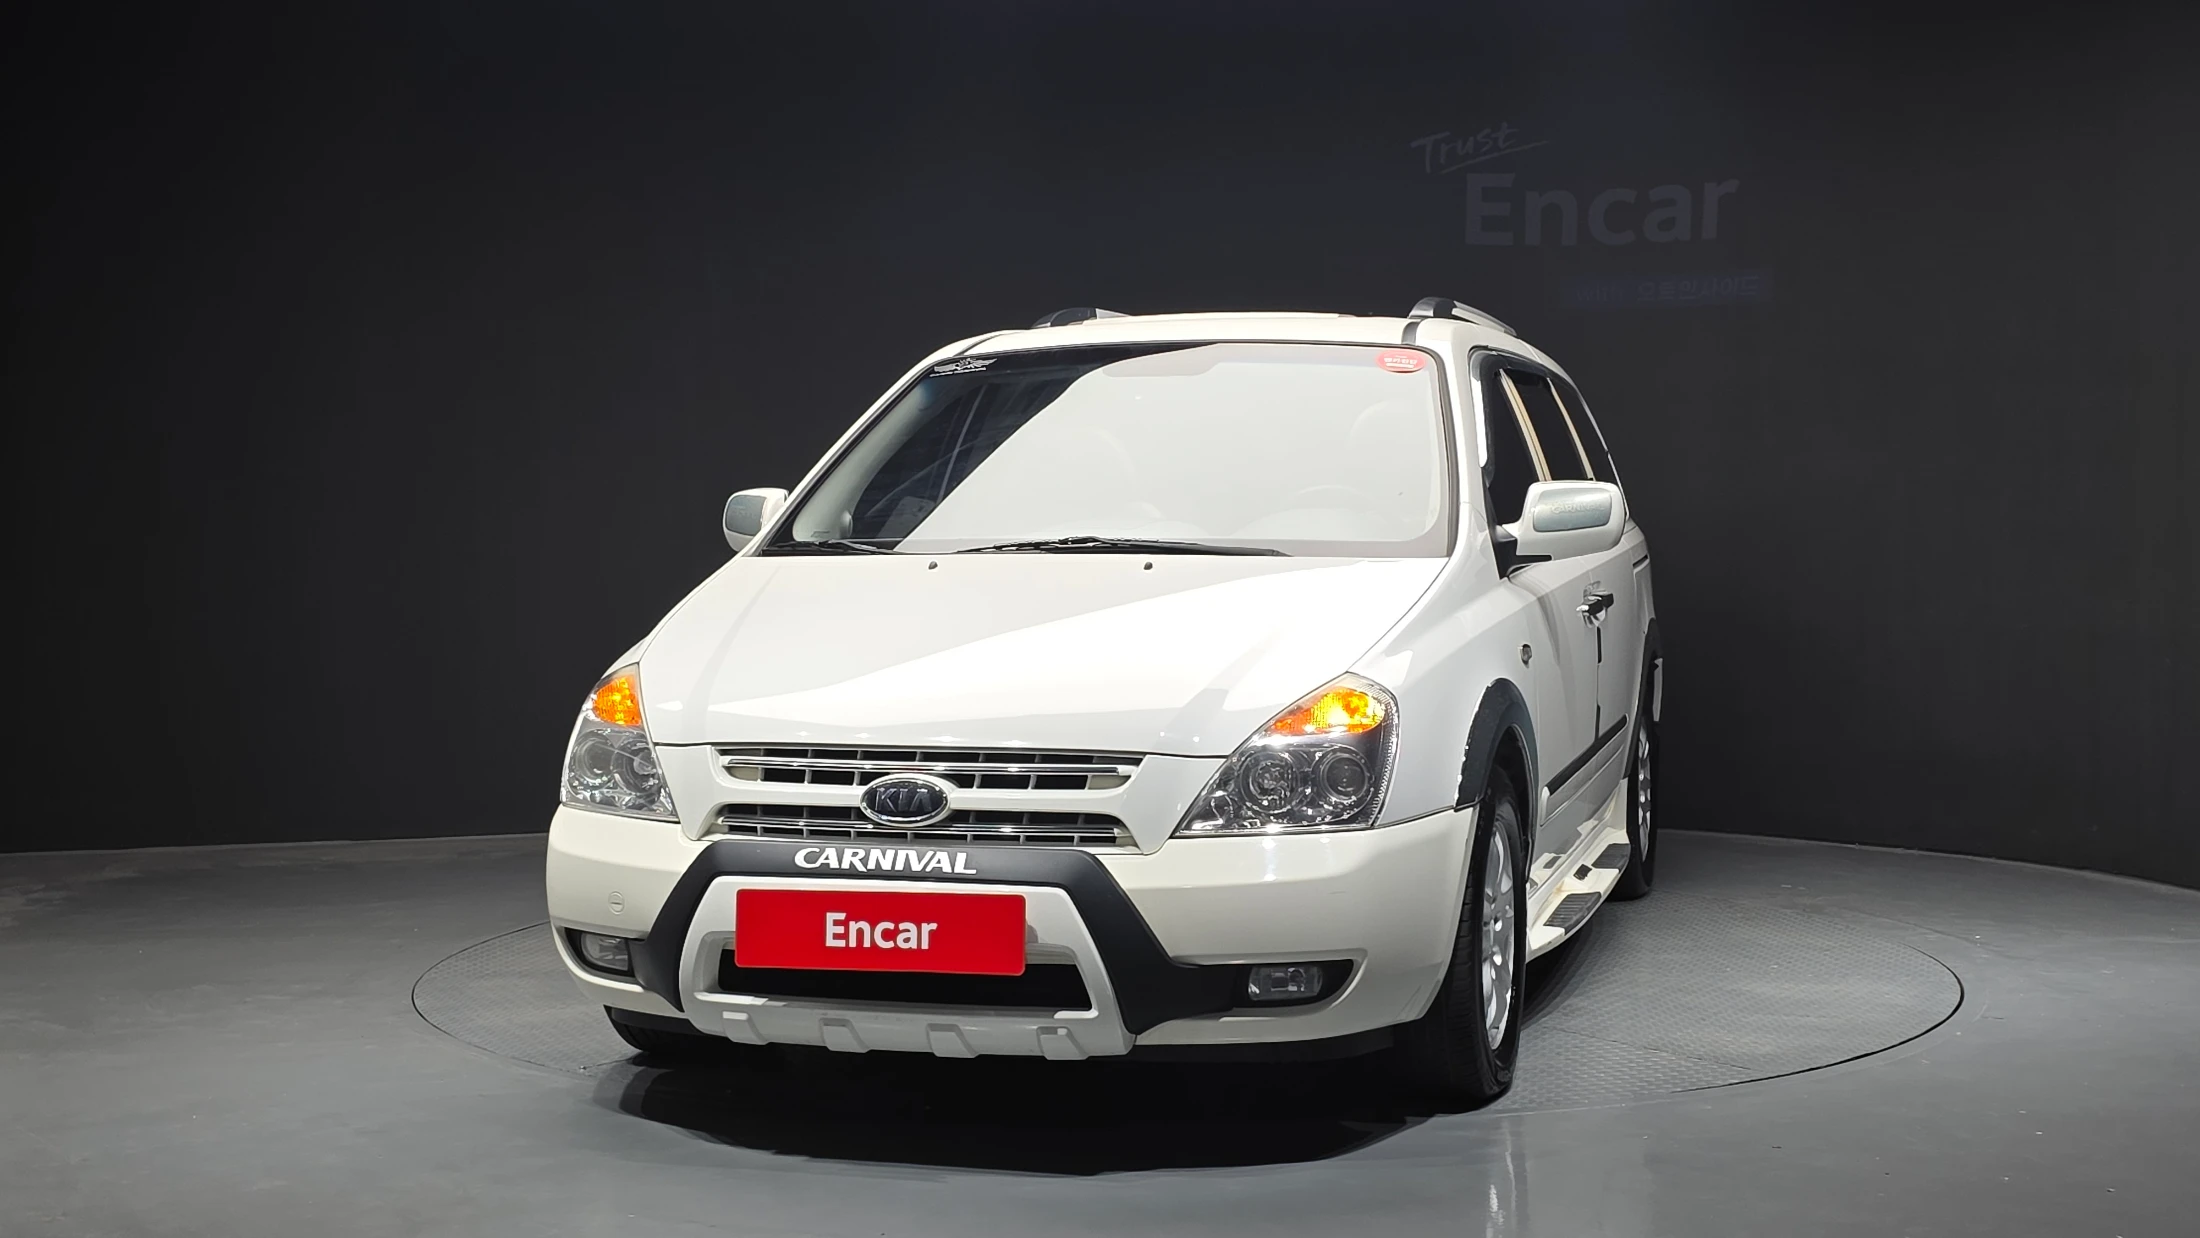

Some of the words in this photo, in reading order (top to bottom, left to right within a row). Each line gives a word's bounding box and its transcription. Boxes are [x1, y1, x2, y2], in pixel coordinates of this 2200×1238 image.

[1410, 121, 1521, 173] Trust
[1464, 172, 1740, 246] Encar
[875, 787, 932, 812] KIA
[794, 847, 977, 875] CARNIVAL
[825, 912, 938, 950] Encar
